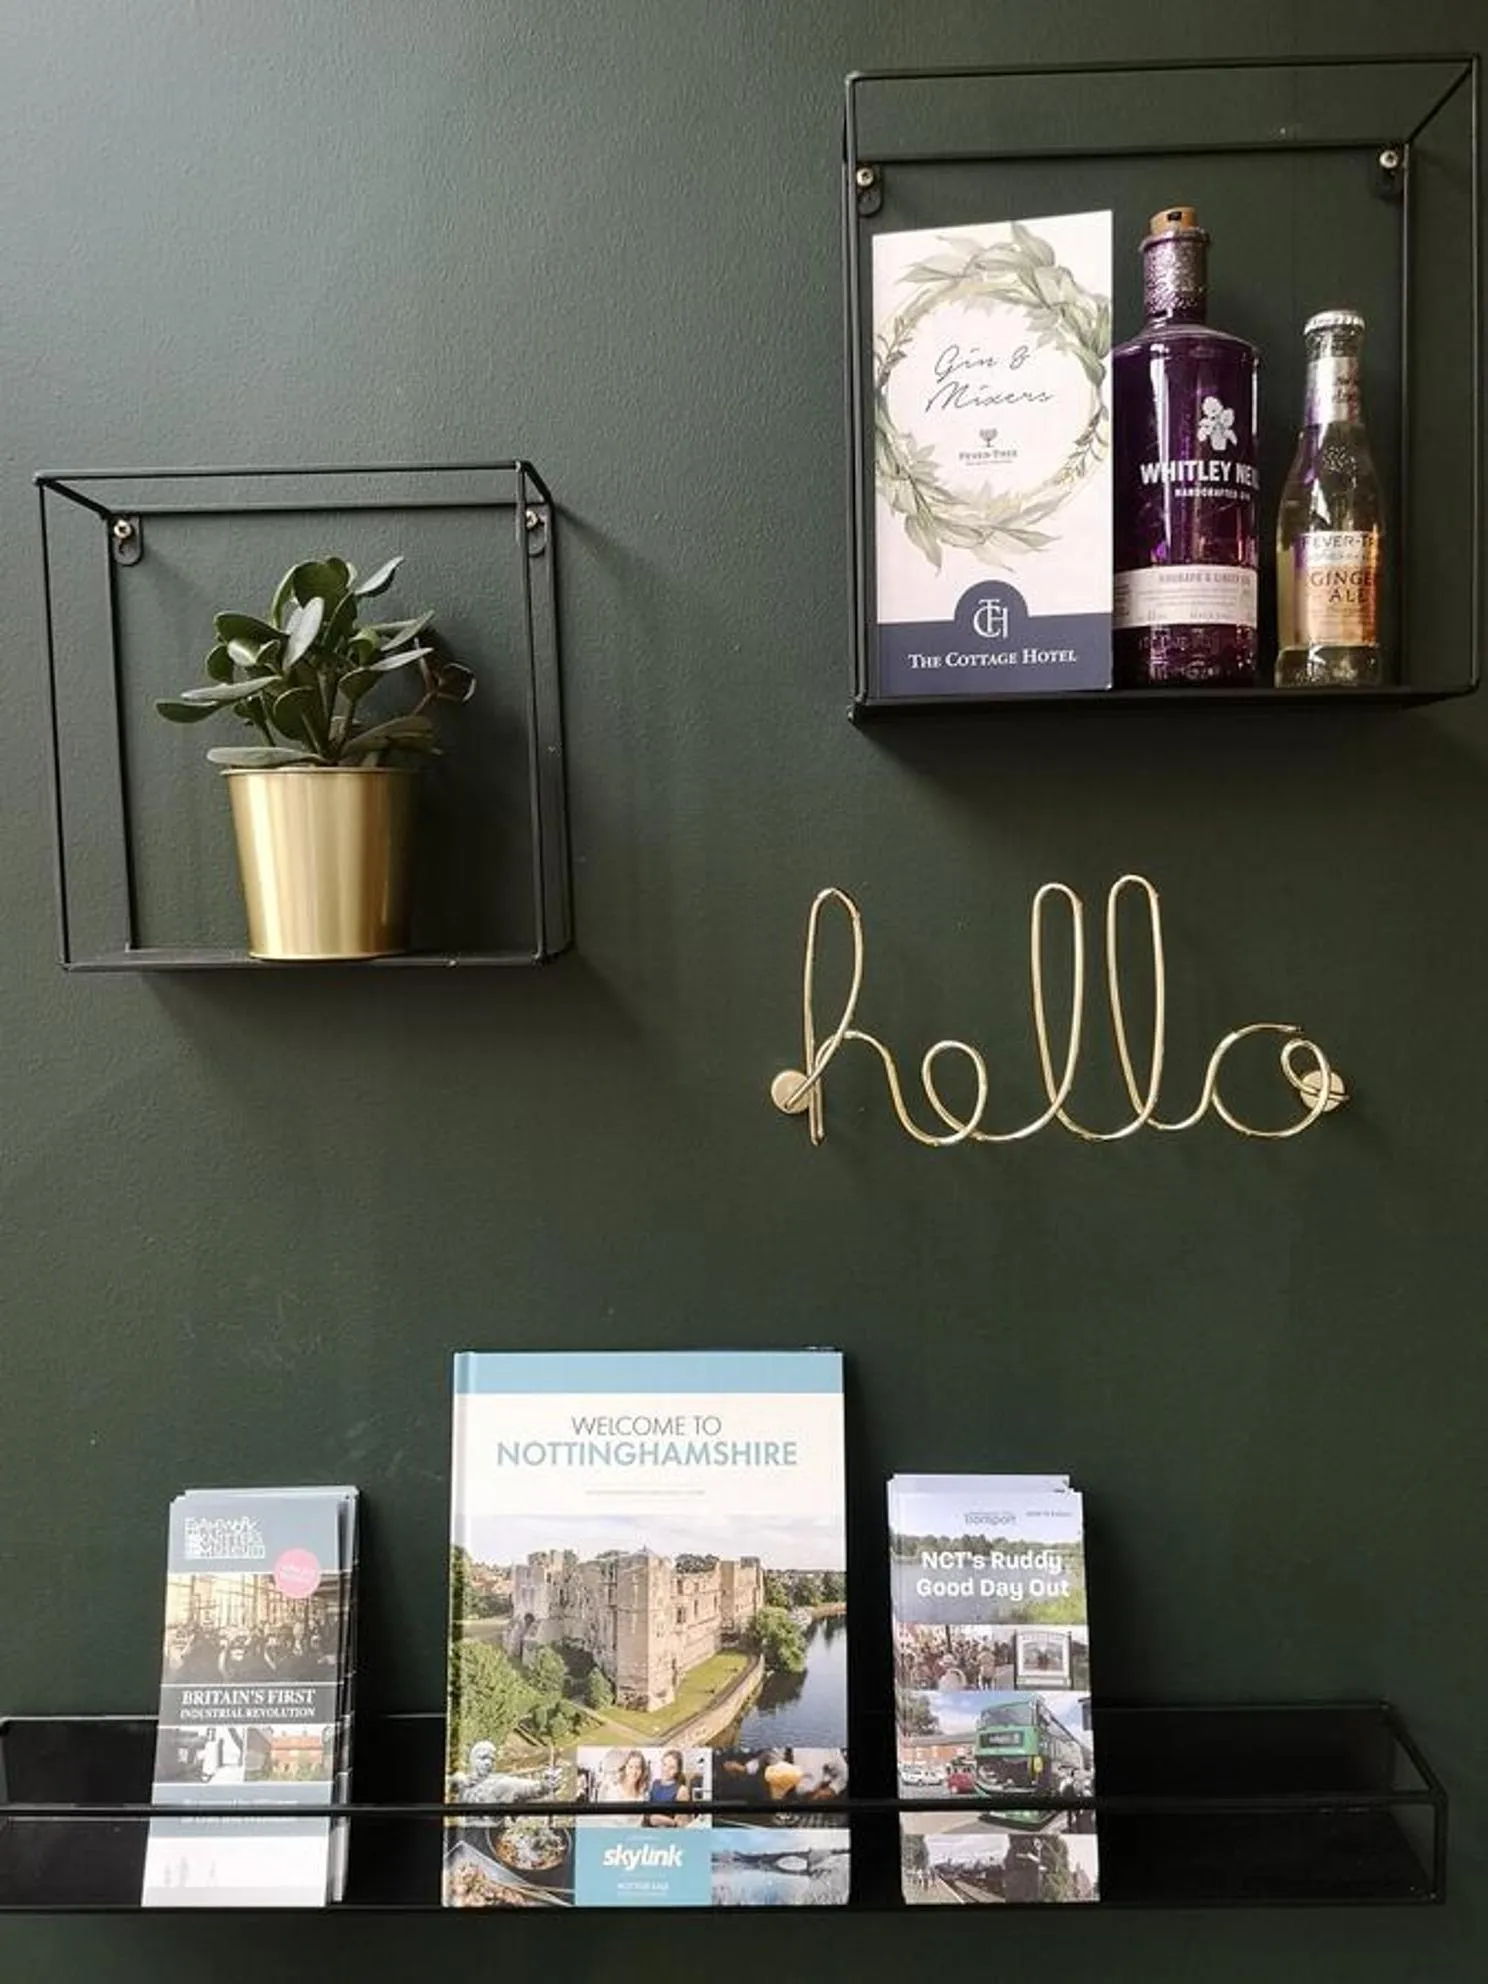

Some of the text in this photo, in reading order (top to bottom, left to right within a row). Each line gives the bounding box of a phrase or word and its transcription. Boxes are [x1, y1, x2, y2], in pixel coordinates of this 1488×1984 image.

[934, 344, 1031, 384] Gin &
[925, 381, 1055, 413] Mixers
[1140, 460, 1231, 485] WHITLEY
[1328, 588, 1366, 604] ALE
[907, 647, 1077, 669] THE COTTAGE HOTEL
[785, 873, 1348, 1146] hello
[571, 1415, 723, 1437] WELCOME TO
[496, 1440, 798, 1467] NOTTINGHAMSHIRE
[921, 1550, 1064, 1576] NCT's Ruddy
[915, 1578, 1071, 1601] Good Day Out
[181, 1688, 317, 1706] BRITAIN'S FIRST
[179, 1706, 316, 1720] INDUSTRIAL REVOLUTION
[603, 1843, 683, 1871] skylink
